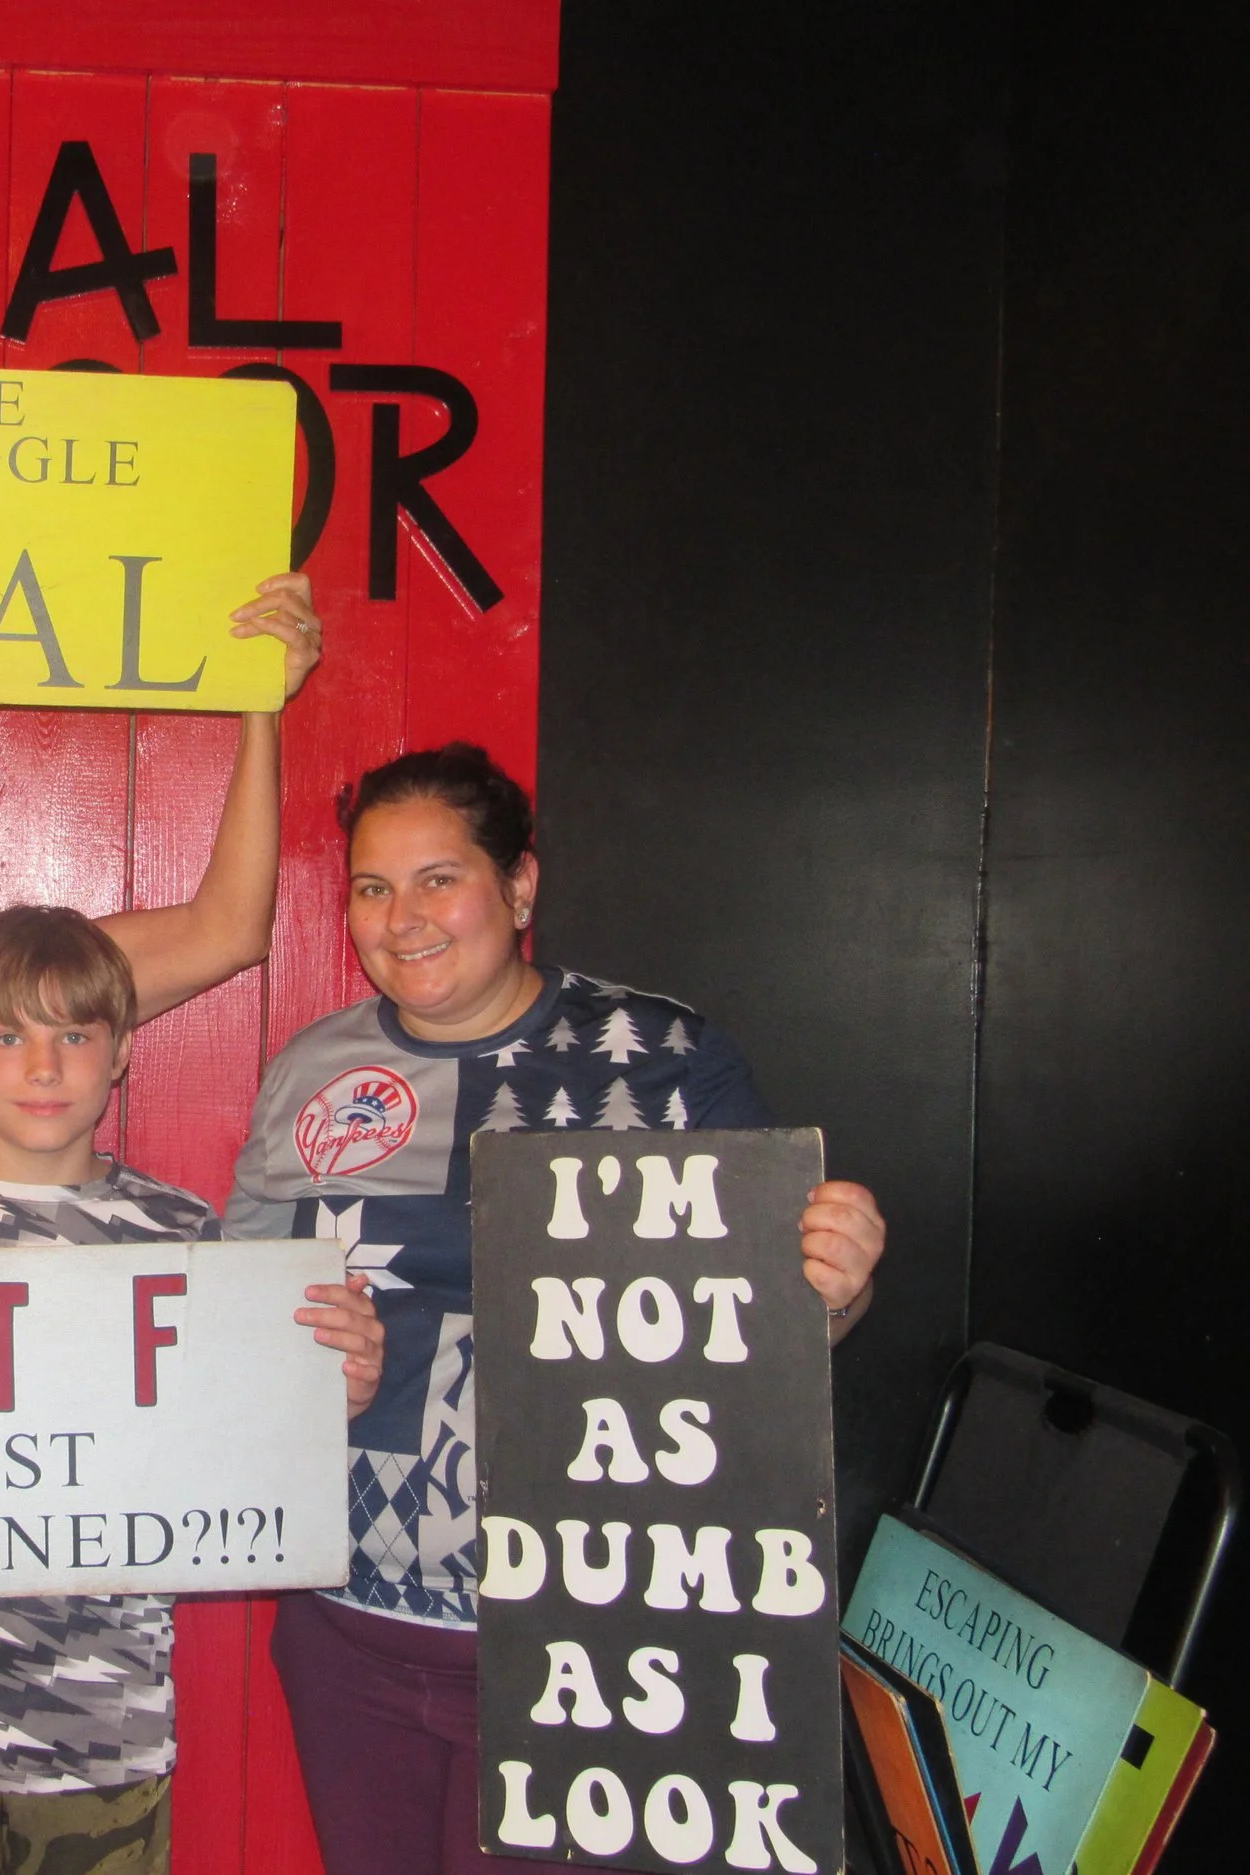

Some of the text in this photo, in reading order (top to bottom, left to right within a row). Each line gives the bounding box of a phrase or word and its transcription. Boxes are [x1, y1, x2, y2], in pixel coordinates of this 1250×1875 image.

[296, 1113, 406, 1175] Yankees
[547, 1154, 728, 1240] I'M
[529, 1276, 753, 1363] NOT
[567, 1397, 717, 1486] AS
[479, 1516, 826, 1616] DUMB
[915, 1568, 1055, 1690] ESCAPING
[530, 1640, 776, 1741] AS I
[861, 1608, 1073, 1793] BRINGS OUT MY
[498, 1760, 818, 1874] LOOK
